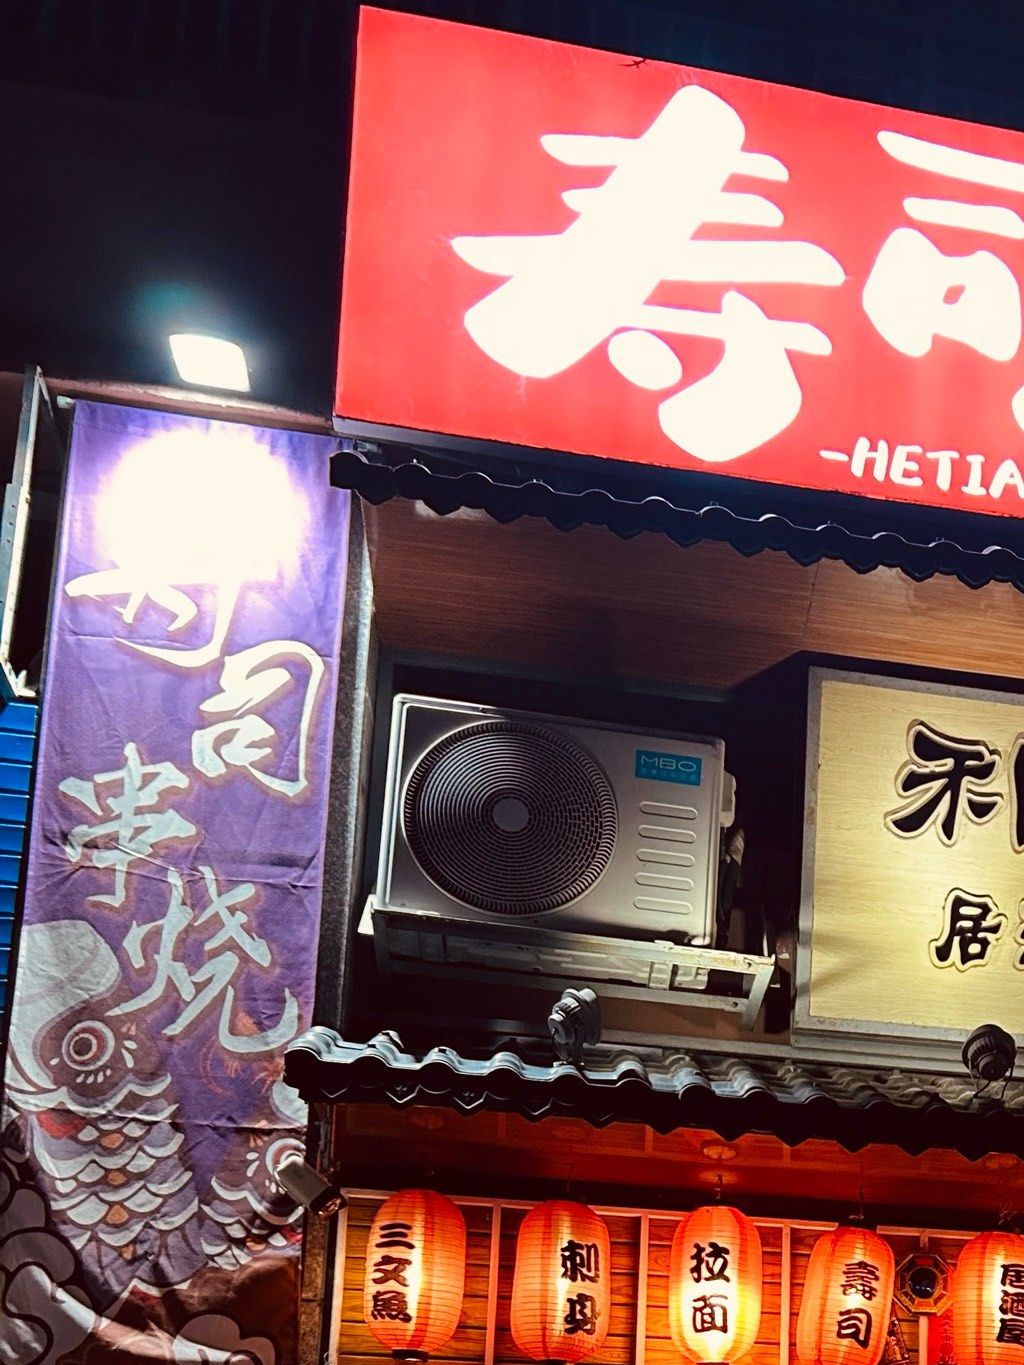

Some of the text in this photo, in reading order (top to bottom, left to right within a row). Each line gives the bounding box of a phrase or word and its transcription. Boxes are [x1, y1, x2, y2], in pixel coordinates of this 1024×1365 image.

[641, 755, 697, 772] MBO
[371, 1222, 413, 1325] 三文魚
[560, 1240, 601, 1336] 刺身
[690, 1243, 731, 1334] 拉面
[836, 1260, 880, 1348] 壽司
